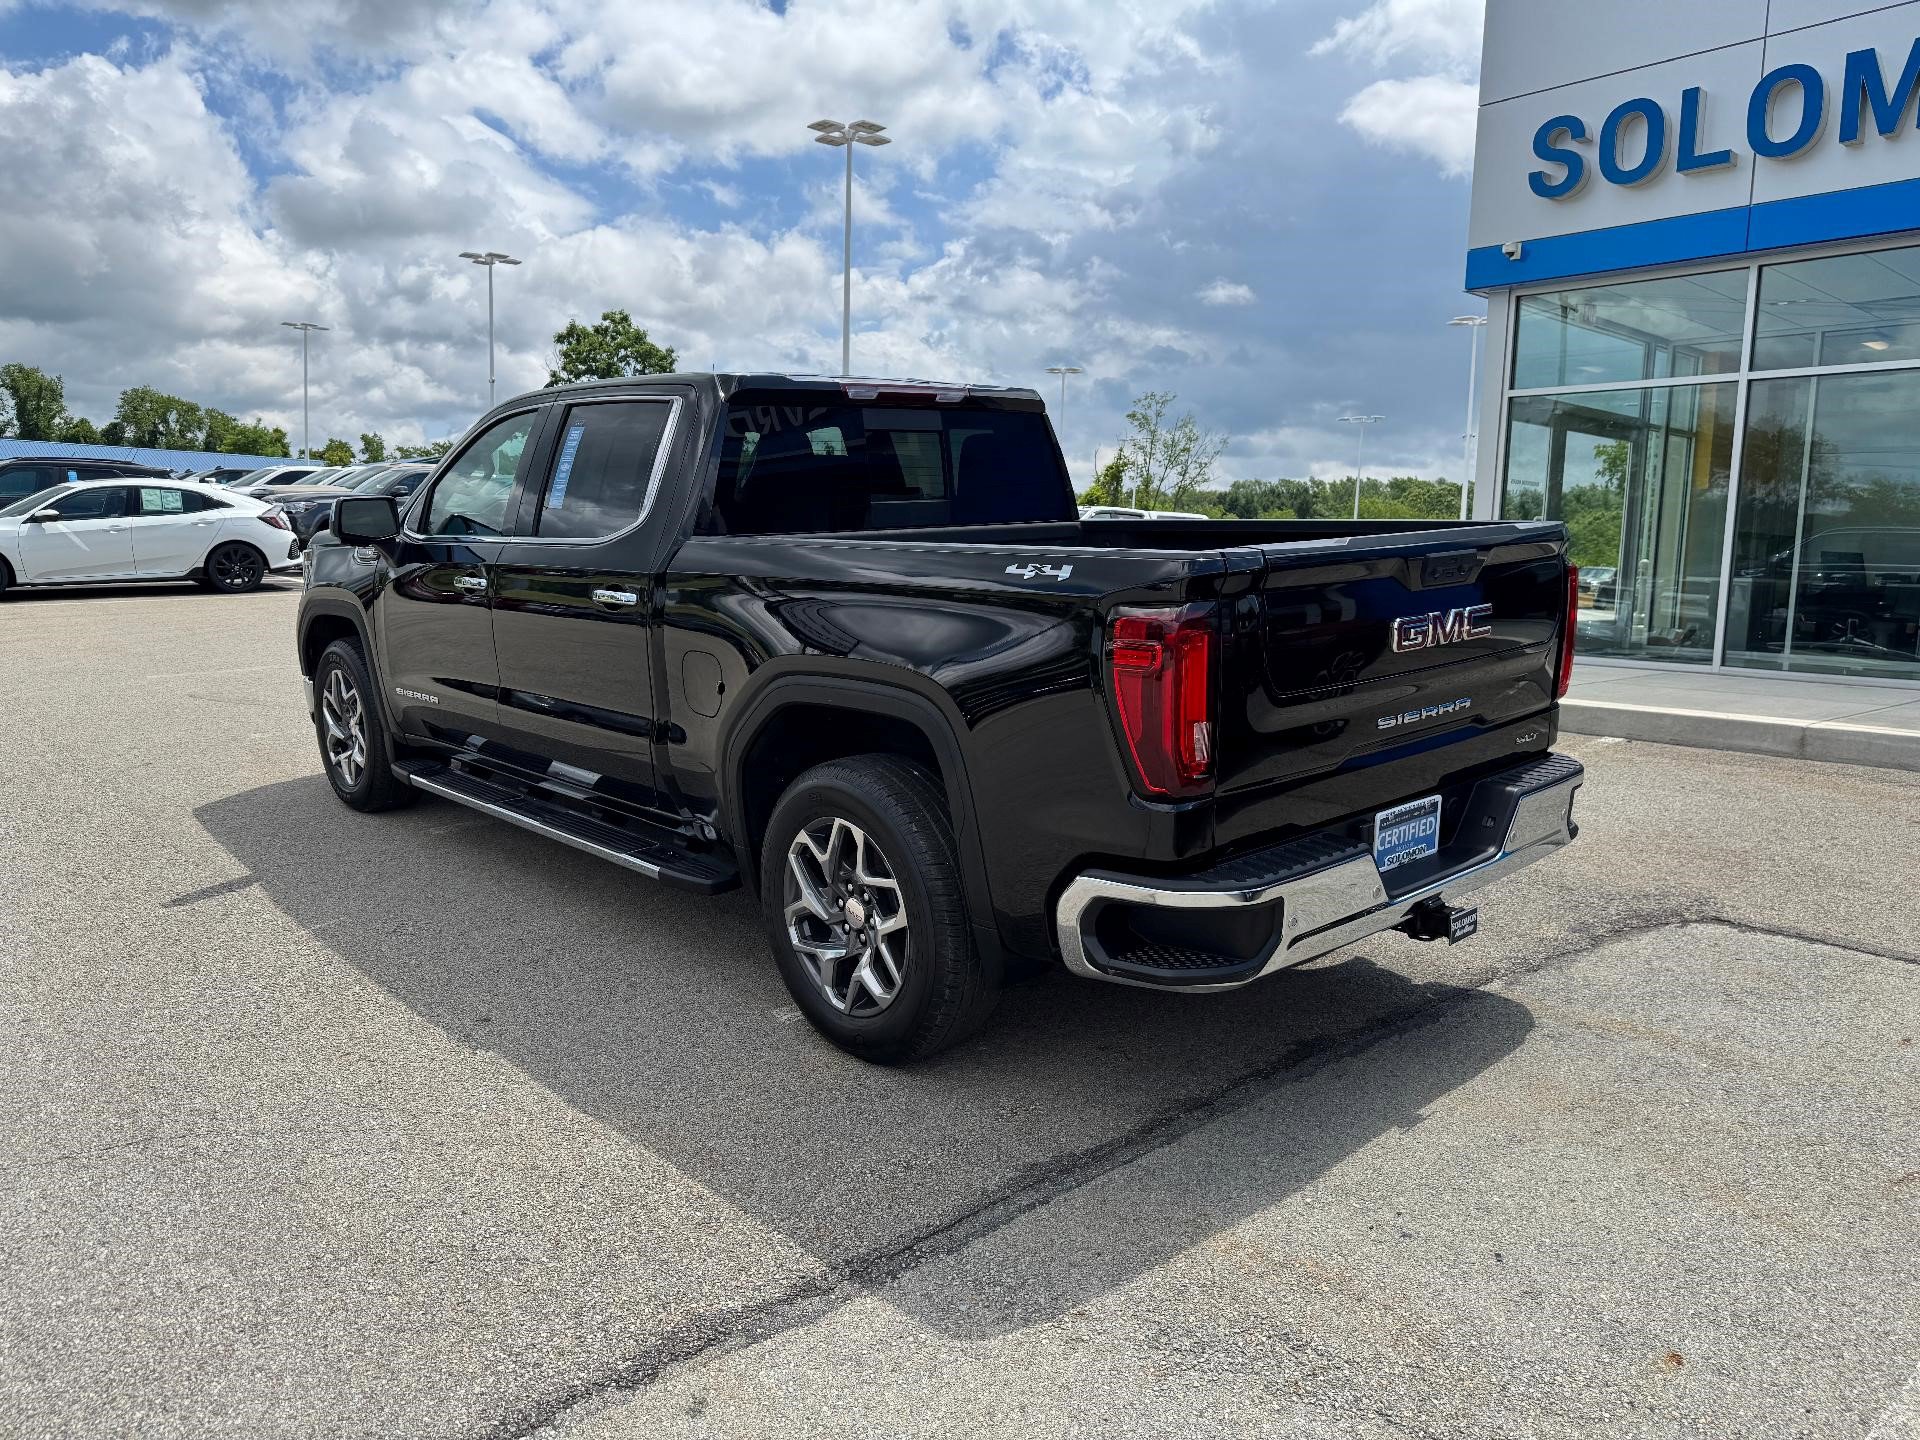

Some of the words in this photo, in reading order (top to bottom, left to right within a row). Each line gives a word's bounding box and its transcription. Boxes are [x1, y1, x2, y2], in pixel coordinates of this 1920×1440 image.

[1528, 37, 1920, 200] SOLOM
[1393, 603, 1493, 653] GMC
[396, 687, 439, 704] SIERRA
[1377, 697, 1472, 730] SIERRA
[1377, 816, 1436, 851] CERTIFIED
[1386, 843, 1427, 867] SOLOMON
[1451, 912, 1477, 931] SOLOMON
